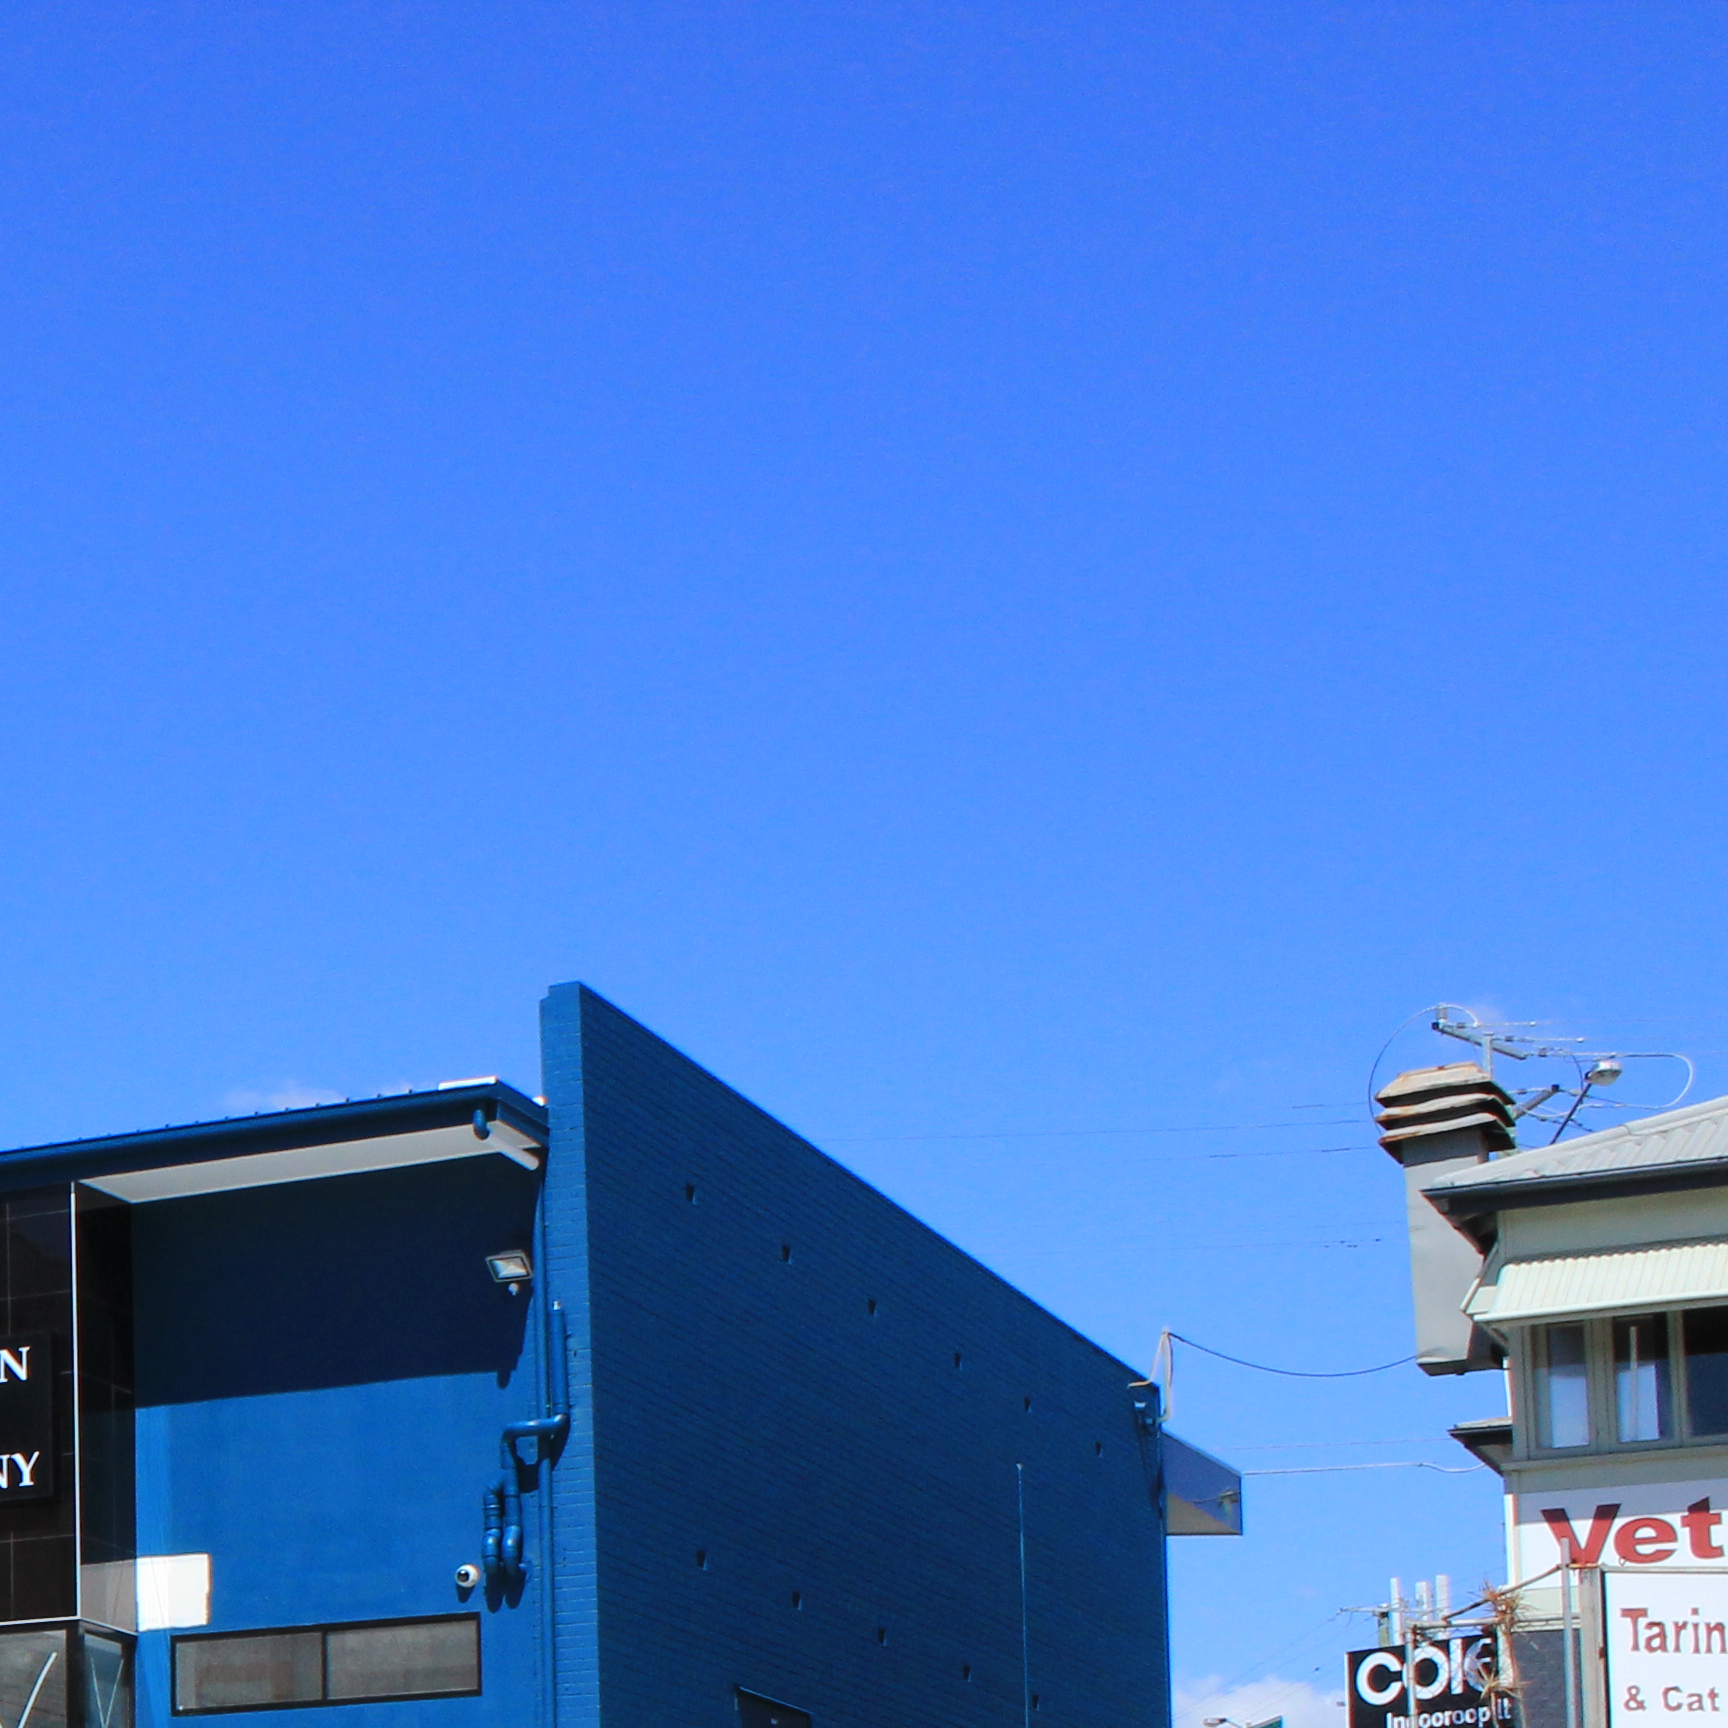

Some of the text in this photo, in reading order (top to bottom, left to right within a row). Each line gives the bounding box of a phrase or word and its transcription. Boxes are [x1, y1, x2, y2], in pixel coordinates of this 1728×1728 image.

[1540, 1496, 1725, 1565] Vet
[1619, 1607, 1728, 1654] Tarin
[1623, 1685, 1721, 1712] & Cat
